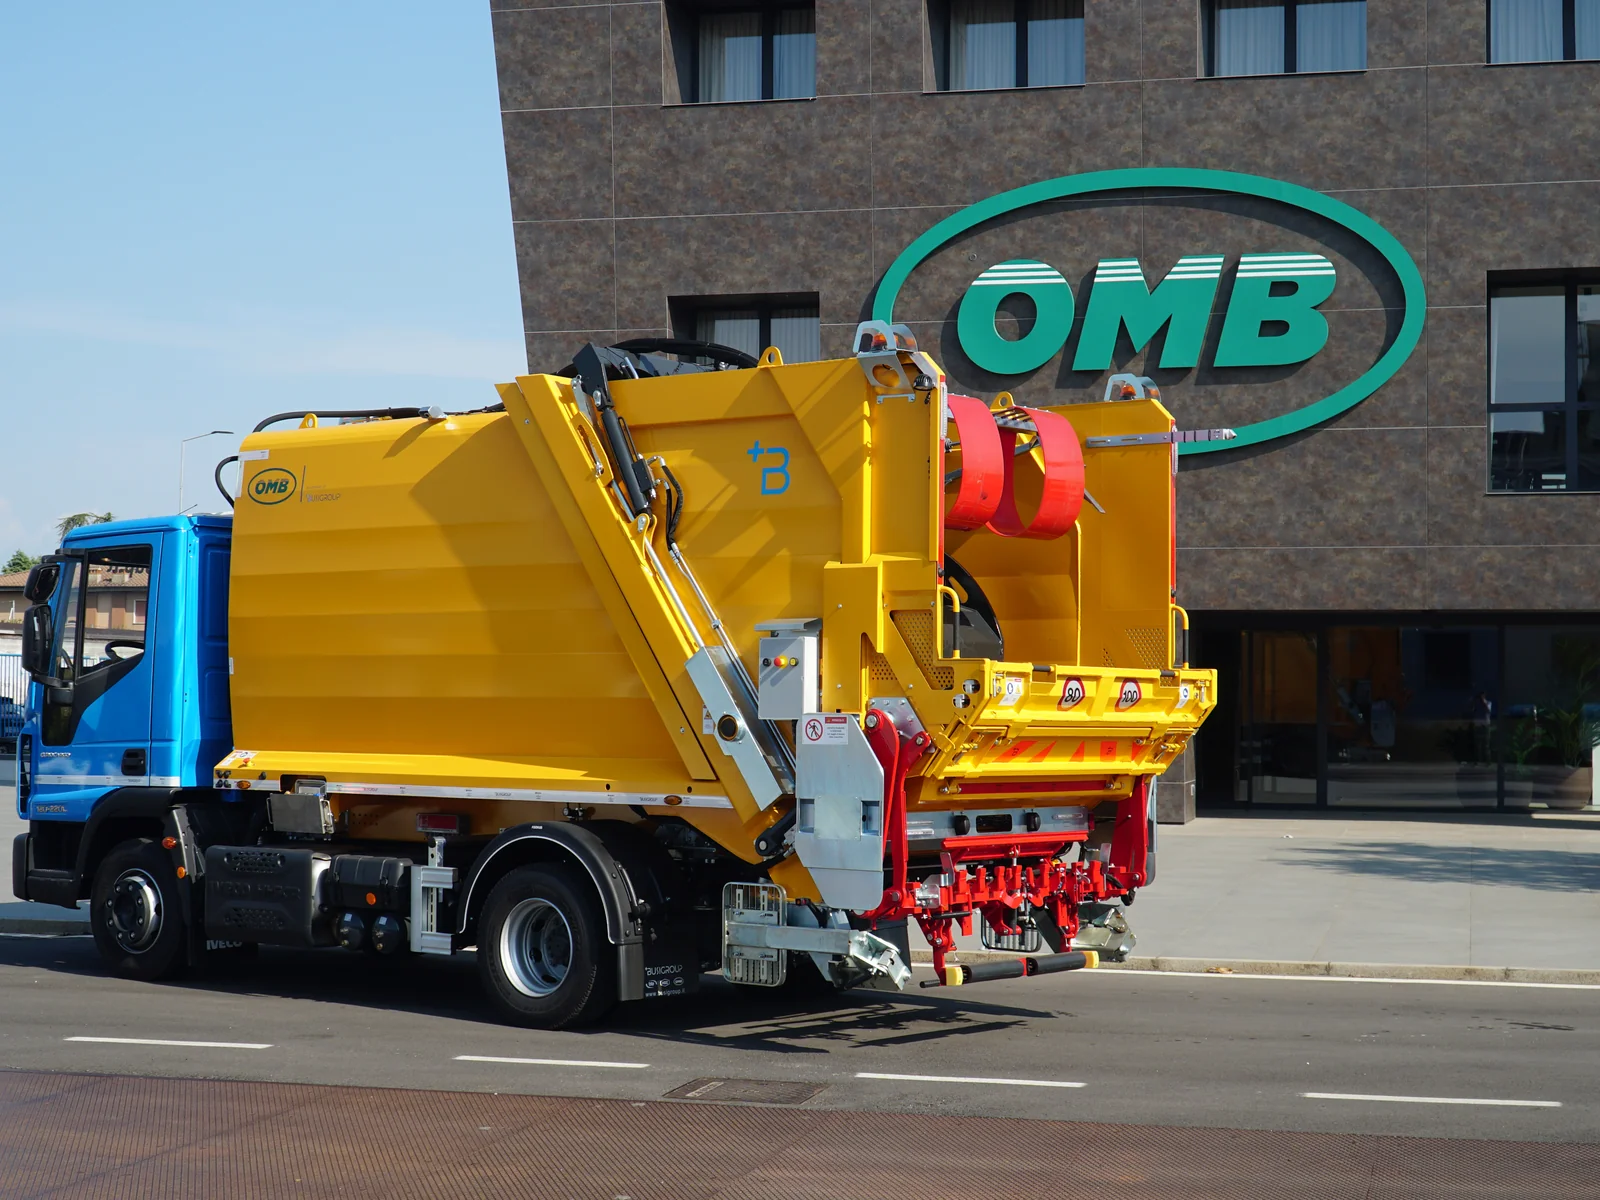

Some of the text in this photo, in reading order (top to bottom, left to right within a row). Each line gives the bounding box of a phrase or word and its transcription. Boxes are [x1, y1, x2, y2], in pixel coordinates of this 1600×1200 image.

[957, 252, 1336, 375] OMB
[255, 478, 290, 495] OMB
[1064, 687, 1081, 702] 80
[1121, 690, 1138, 703] 100
[206, 940, 242, 951] IVECO
